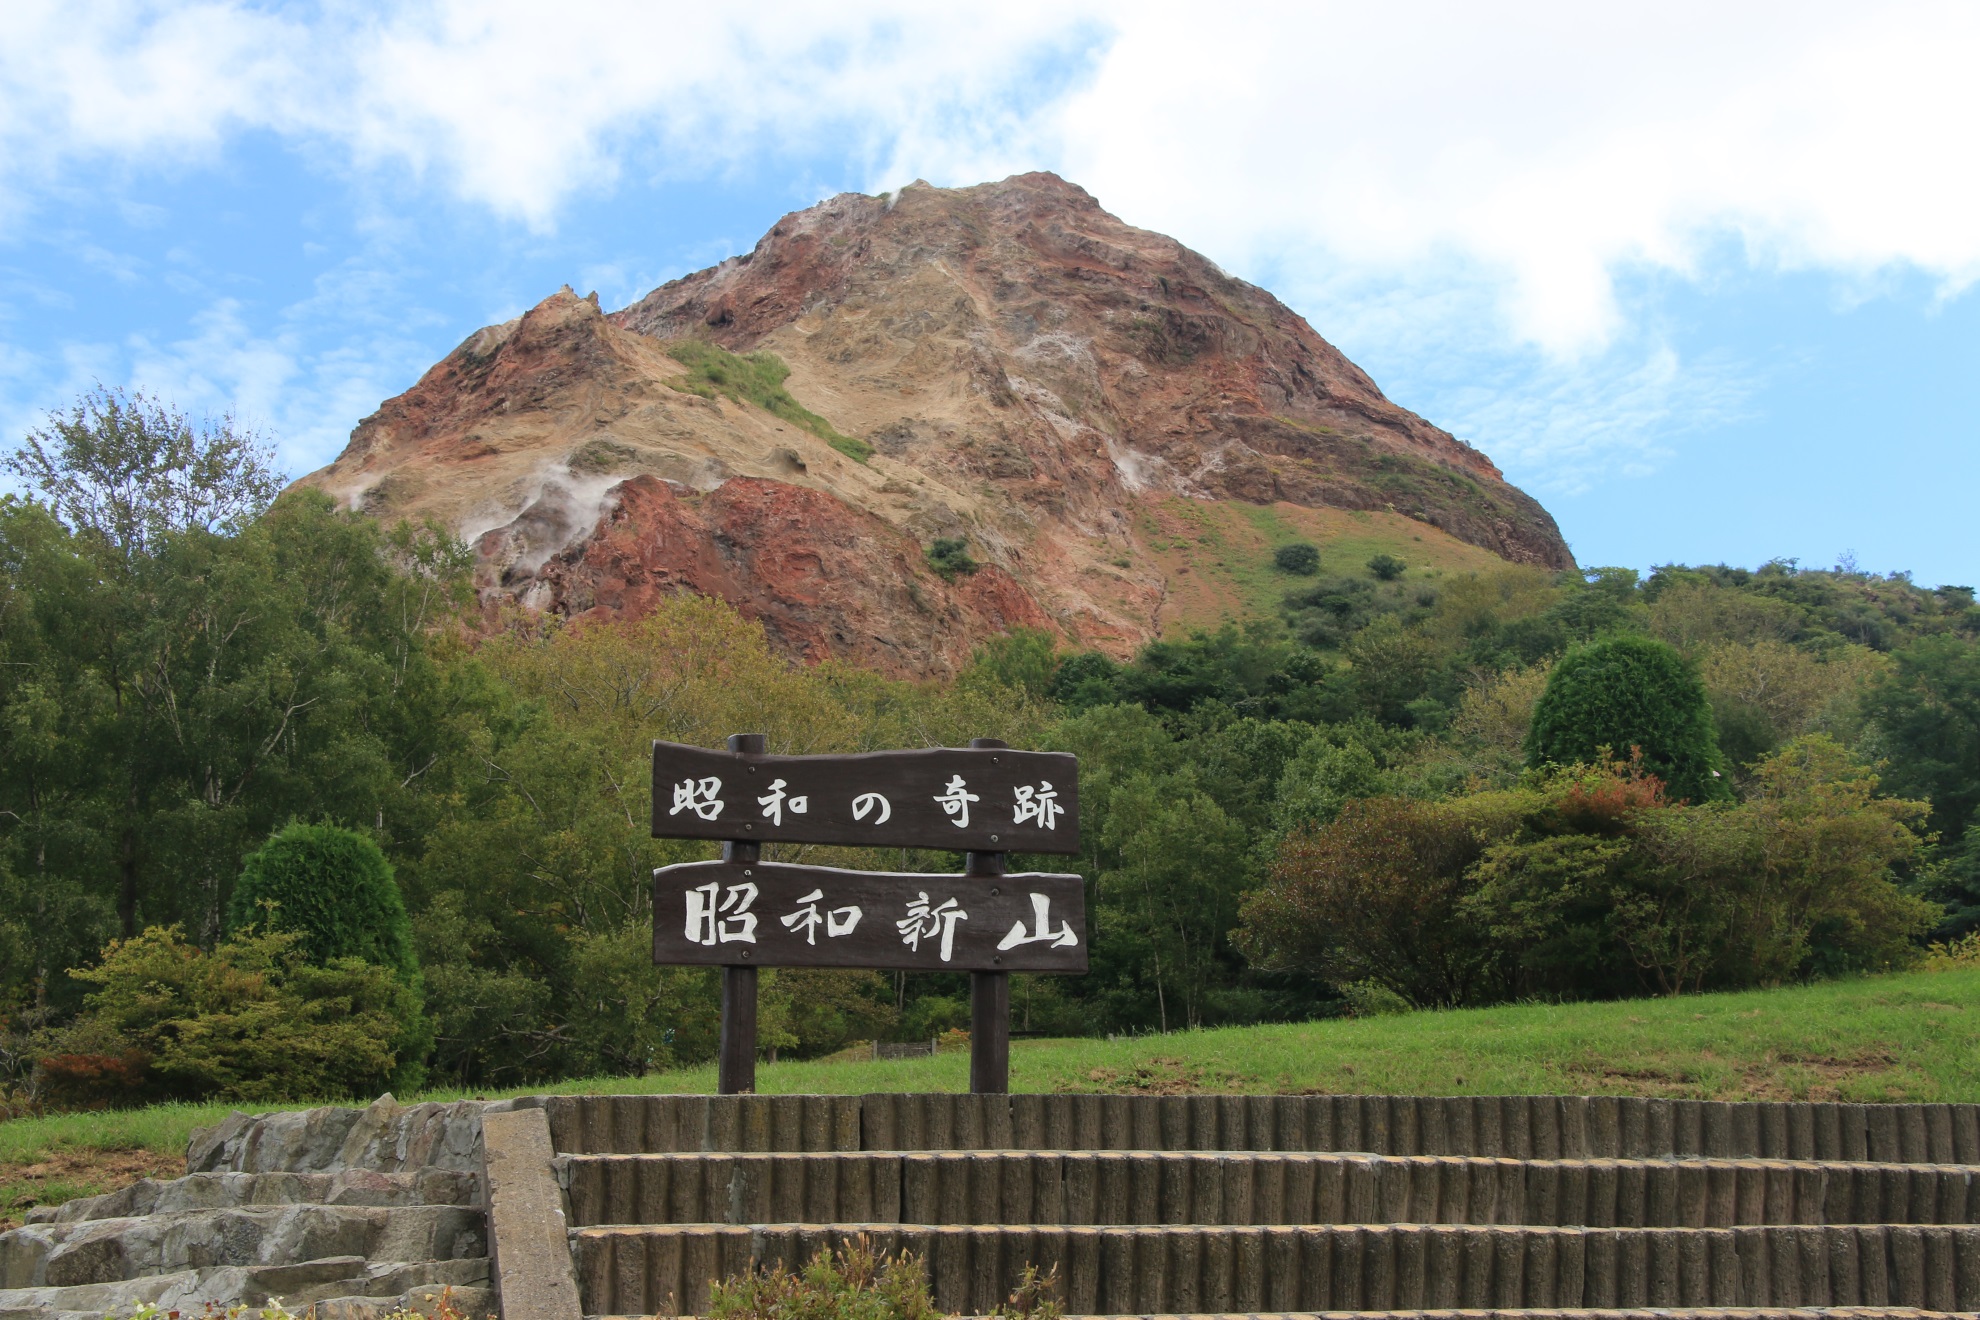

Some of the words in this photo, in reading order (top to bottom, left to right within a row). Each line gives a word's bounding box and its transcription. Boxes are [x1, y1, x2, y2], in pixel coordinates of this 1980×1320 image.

[669, 774, 1065, 831] 昭和の奇跡
[684, 881, 1079, 962] 昭和新山
